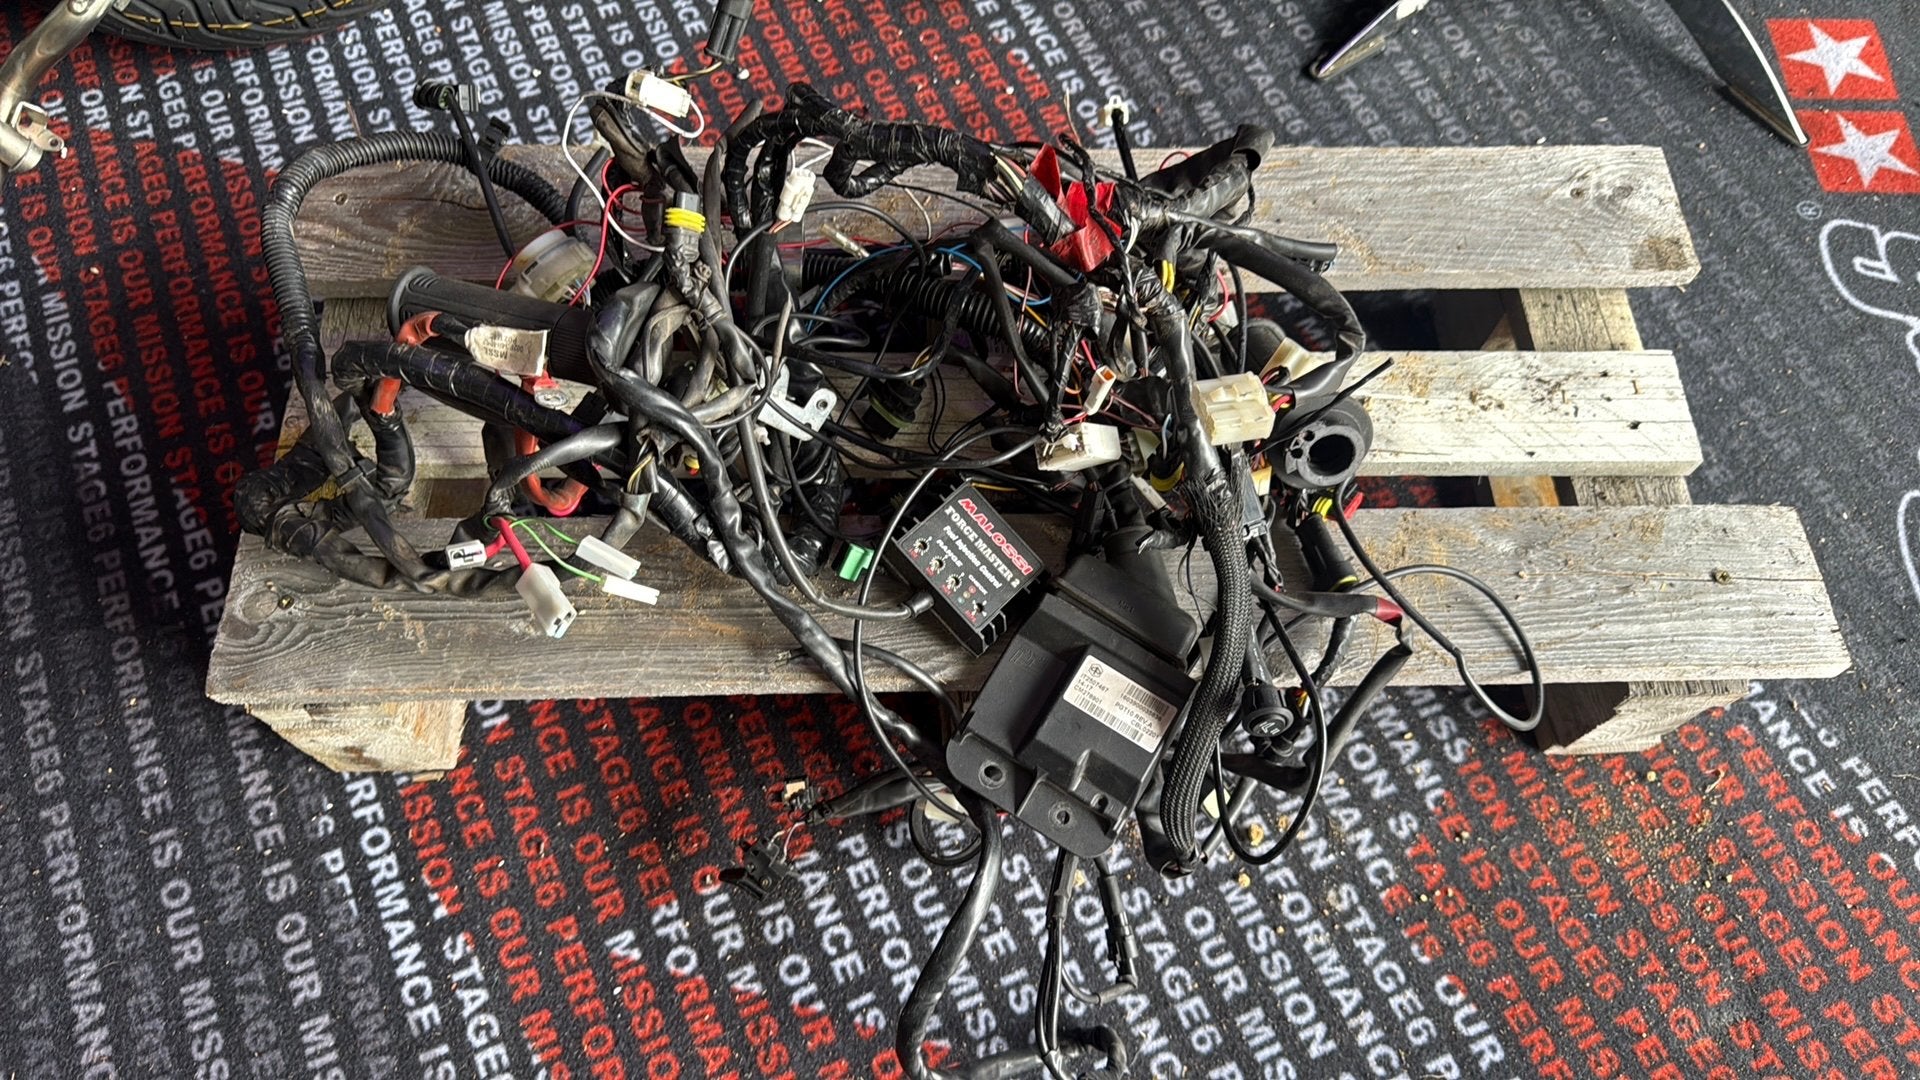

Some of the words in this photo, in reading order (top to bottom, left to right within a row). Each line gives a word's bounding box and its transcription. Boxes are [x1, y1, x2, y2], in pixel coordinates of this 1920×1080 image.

[337, 20, 384, 102] ISSION
[370, 8, 435, 134] PERFORMA
[406, 0, 445, 56] AGE6
[450, 15, 505, 105] STAGE6
[482, 1, 542, 100] MISSION
[523, 3, 594, 146] PERFORMAN
[606, 21, 635, 47] IS
[635, 0, 689, 76] ISSION
[787, 0, 845, 78] ISSION
[862, 0, 918, 71] TAGE6
[918, 28, 961, 80] OUR
[988, 19, 1017, 45] IS
[1006, 48, 1051, 101] OUR
[1138, 18, 1167, 43] IS
[1158, 46, 1204, 98] OUR
[69, 44, 131, 213] ERFORMANCE
[199, 88, 236, 143] OUR
[265, 43, 319, 145] MISSION
[848, 39, 877, 66] IS
[864, 68, 908, 121] OUR
[958, 33, 1040, 144] PERFORM
[1056, 69, 1086, 95] IS
[1395, 58, 1468, 145] MISSIO
[1127, 120, 1156, 147] IS
[19, 193, 48, 222] IS
[54, 148, 100, 257] MISSION
[110, 215, 138, 246] IS
[172, 132, 248, 328] PERFORMANCE
[228, 333, 257, 364] IS
[216, 145, 265, 258] MISSION
[117, 249, 155, 311] OUR
[126, 110, 174, 208] STAGE6
[151, 208, 228, 418] PERFORMANCE
[206, 421, 237, 456] IS
[41, 291, 89, 413] MISSION
[133, 313, 185, 441] MISSION
[67, 420, 116, 543] STAGE6
[943, 525, 959, 541] Fuel
[955, 539, 982, 567] Injection
[979, 565, 1003, 589] Control
[944, 505, 979, 543] FORCE
[974, 538, 1014, 582] MASTER
[1010, 577, 1021, 588] 2
[958, 498, 1034, 576] MALOSSI
[15, 651, 65, 795] STAGE6
[96, 549, 174, 819] PERFORMANCE
[149, 827, 183, 869] IS
[395, 778, 464, 921] ISSION
[556, 784, 593, 826] IS
[673, 814, 712, 858] IS
[1402, 686, 1519, 832] MISSION
[1509, 842, 1624, 1001] STAGE6
[1502, 750, 1624, 917] MISSION
[1676, 723, 1746, 807] OUR
[1737, 810, 1873, 984] MISSION
[1828, 803, 1870, 845] IS
[261, 858, 300, 903] IS
[343, 773, 442, 1038] RFORMANCE
[473, 855, 511, 899] IS
[574, 833, 626, 924] OUR
[1387, 810, 1498, 968] STAGE6
[1726, 723, 1920, 993] PERFORMANC
[39, 800, 118, 1080] PERFORMANC
[160, 878, 204, 972] OUR
[276, 911, 324, 1009] OUR
[490, 907, 542, 1004] OUR
[494, 754, 568, 909] STAGE6
[545, 914, 627, 1080] PERFOR
[629, 841, 741, 1080] PERFORMA
[692, 864, 746, 961] OUR
[1184, 905, 1249, 1001] OUR
[1460, 848, 1503, 891] IS
[1494, 898, 1565, 992] OUR
[1606, 831, 1734, 1007] MISSION
[1658, 842, 1701, 885] IS
[1693, 893, 1768, 983] OUR
[1707, 836, 1830, 993] STAGE6
[604, 929, 682, 1080] MISSIO
[757, 898, 796, 946] IS
[778, 953, 837, 1051] OUR
[1000, 967, 1039, 1015] IS
[1120, 886, 1224, 1055] STAGE6
[1218, 879, 1338, 1060] MISSION
[1327, 883, 1438, 1046] STAGE6
[1402, 920, 1444, 965] IS
[1434, 973, 1506, 1073] OUR
[179, 976, 230, 1080] MISS
[726, 961, 797, 1080] MISS
[846, 991, 887, 1041] IS
